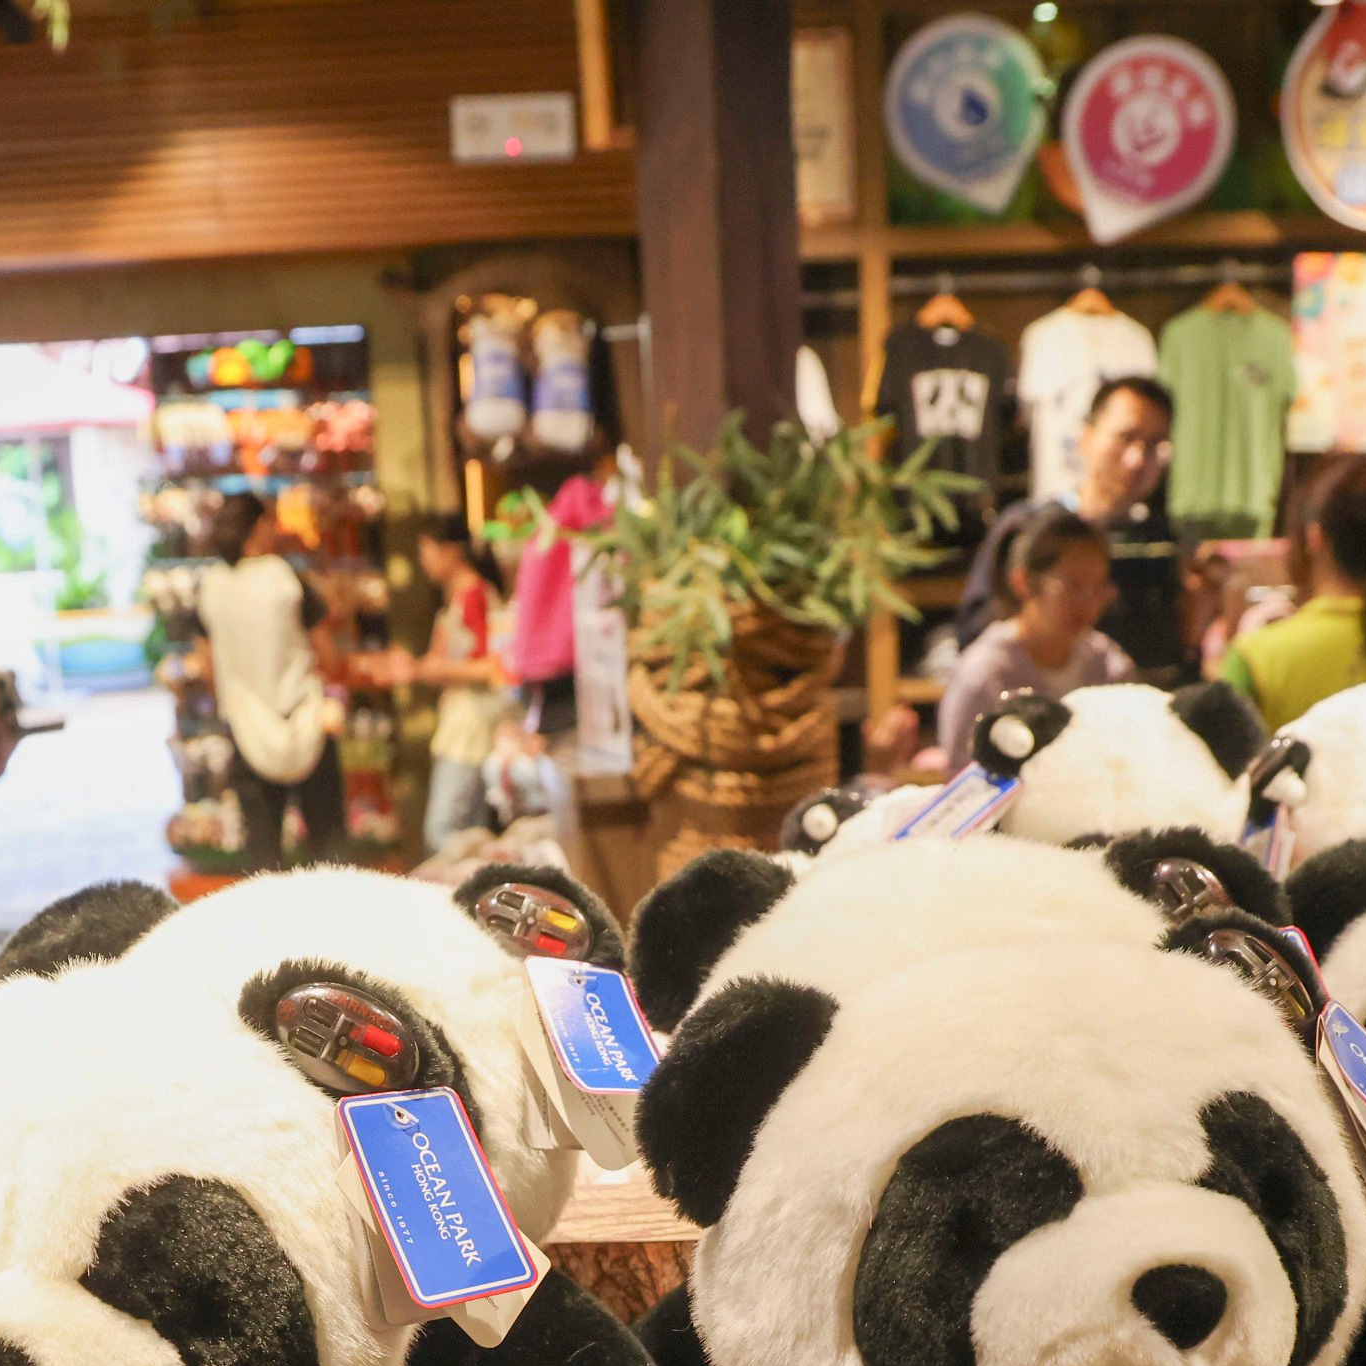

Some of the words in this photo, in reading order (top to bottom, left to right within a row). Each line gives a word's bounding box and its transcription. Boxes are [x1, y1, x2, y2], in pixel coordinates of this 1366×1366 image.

[586, 993, 619, 1047] OCEAN
[608, 1049, 639, 1083] PARK
[411, 1163, 435, 1202] HONG
[428, 1202, 451, 1240] KONG
[412, 1132, 456, 1208] OCEAN
[445, 1212, 482, 1268] PARK
